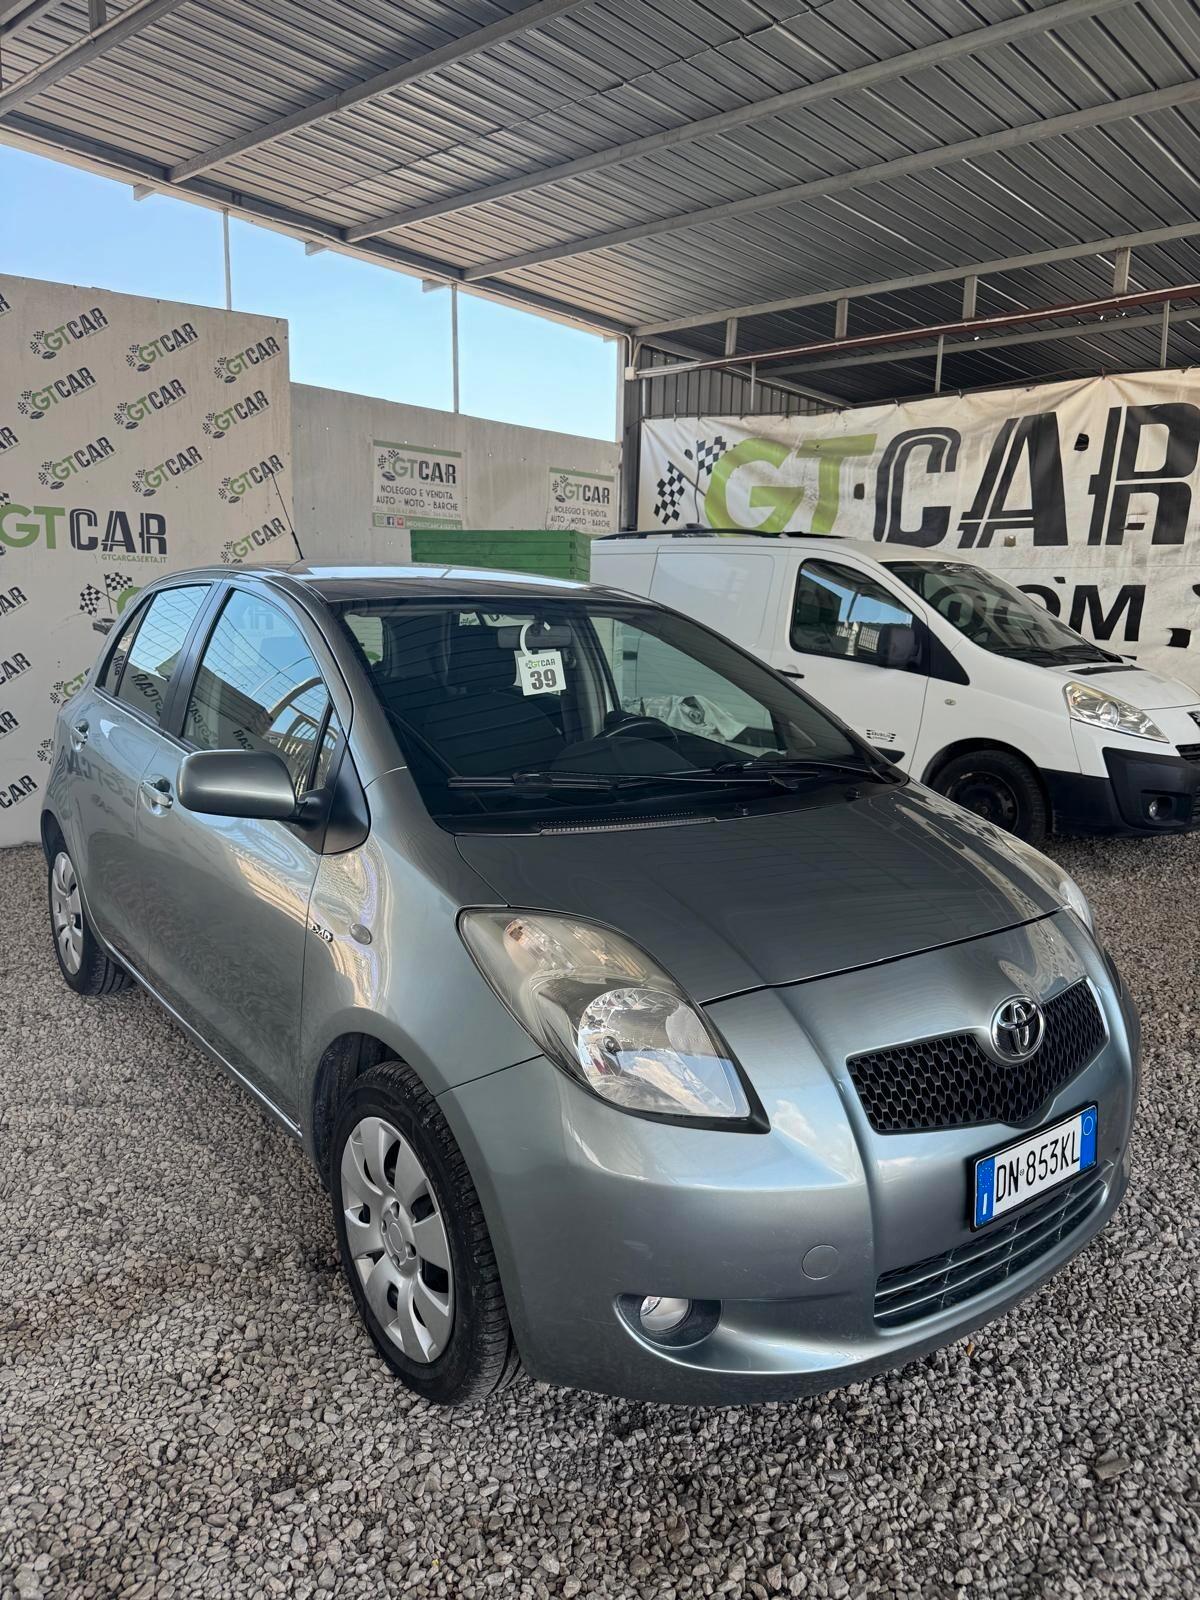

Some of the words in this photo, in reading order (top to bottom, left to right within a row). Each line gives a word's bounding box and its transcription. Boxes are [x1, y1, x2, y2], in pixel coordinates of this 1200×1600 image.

[43, 307, 109, 352] GTCAR
[138, 322, 199, 364] GTCAR
[225, 336, 281, 376] GTCAR
[31, 367, 97, 412] GTCAR
[127, 379, 187, 422] GTCAR
[214, 390, 270, 431] GTCAR
[52, 437, 115, 480] GTCAR
[144, 446, 203, 489] GTCAR
[229, 454, 284, 496] GTCAR
[392, 457, 456, 484] GTCAR
[704, 403, 1200, 548] GTCAR
[376, 496, 396, 505] AUTO
[404, 499, 425, 508] MOTO
[433, 501, 459, 511] BARCHE
[381, 485, 417, 496] NOLEGGIO
[420, 489, 424, 497] E
[425, 489, 453, 500] VENDITA
[563, 482, 610, 504] GTCAR
[0, 503, 168, 555] GTCAR
[233, 517, 286, 557] GTCAR
[551, 515, 565, 523] AUTO
[530, 669, 557, 690] 39
[531, 658, 556, 668] GTCAR
[995, 1157, 1019, 1203] DN
[1026, 1130, 1081, 1187] 853KL
